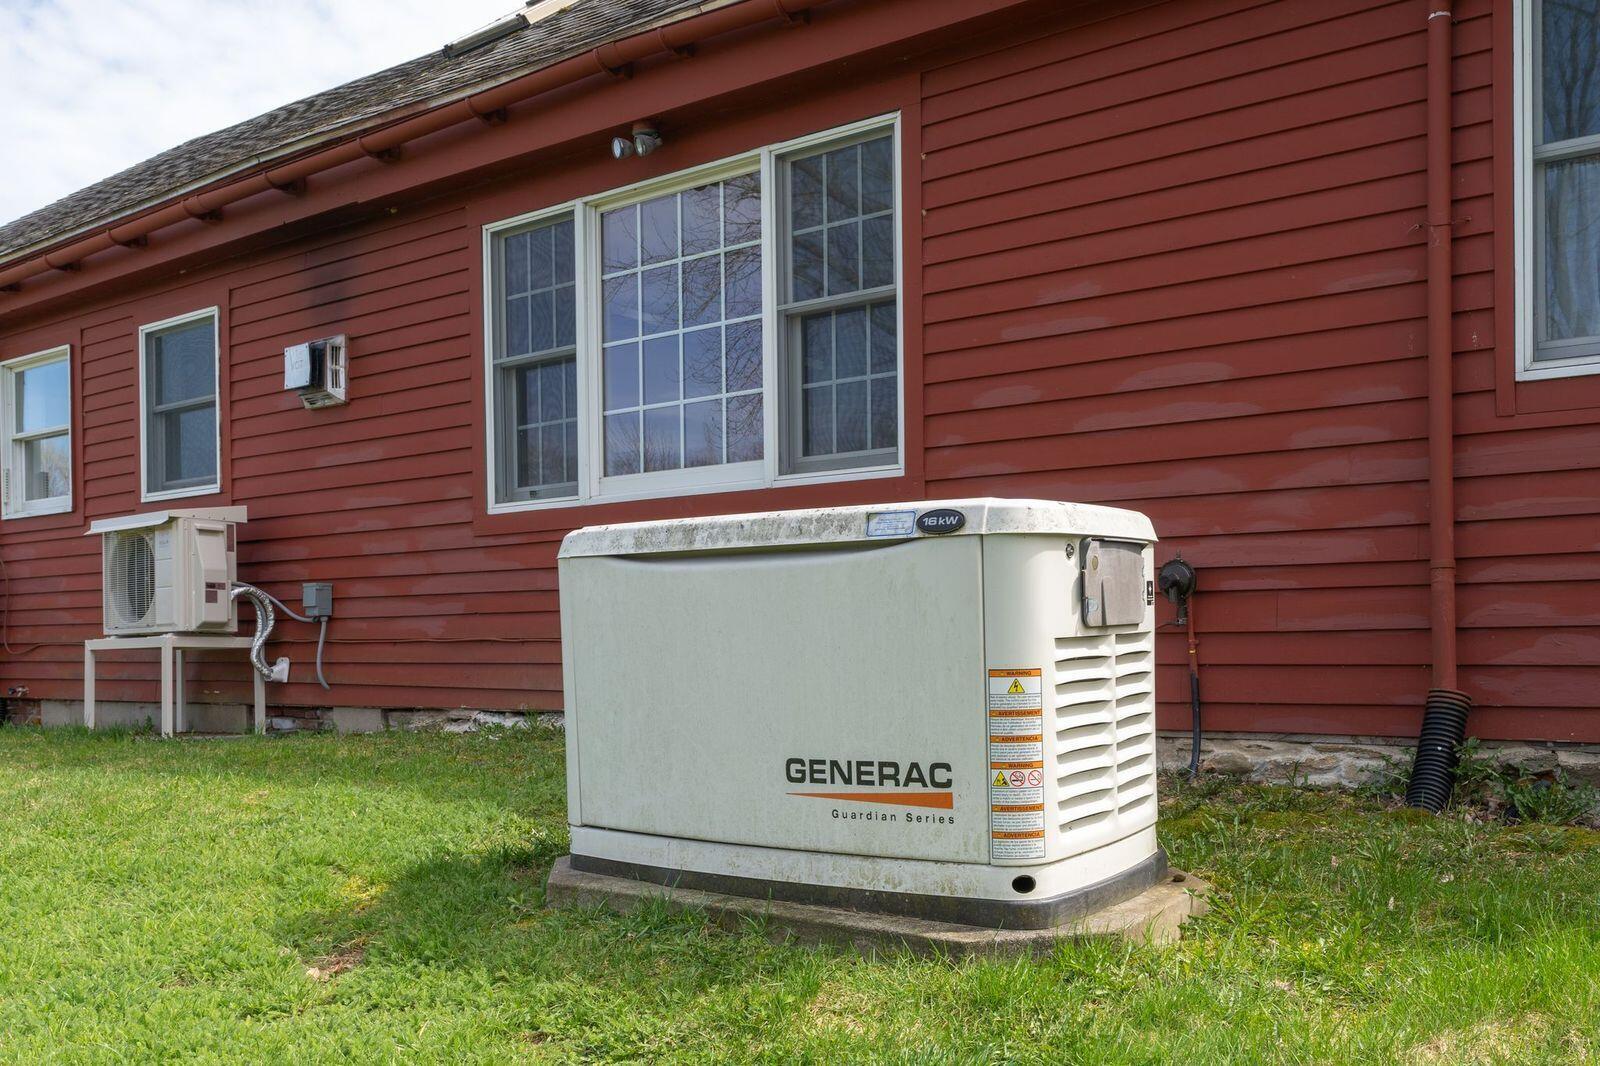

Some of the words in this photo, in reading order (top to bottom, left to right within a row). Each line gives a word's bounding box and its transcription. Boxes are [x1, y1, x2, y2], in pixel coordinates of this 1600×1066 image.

[785, 757, 953, 789] GENERAC
[831, 809, 897, 822] Guardian
[905, 812, 955, 825] Series
